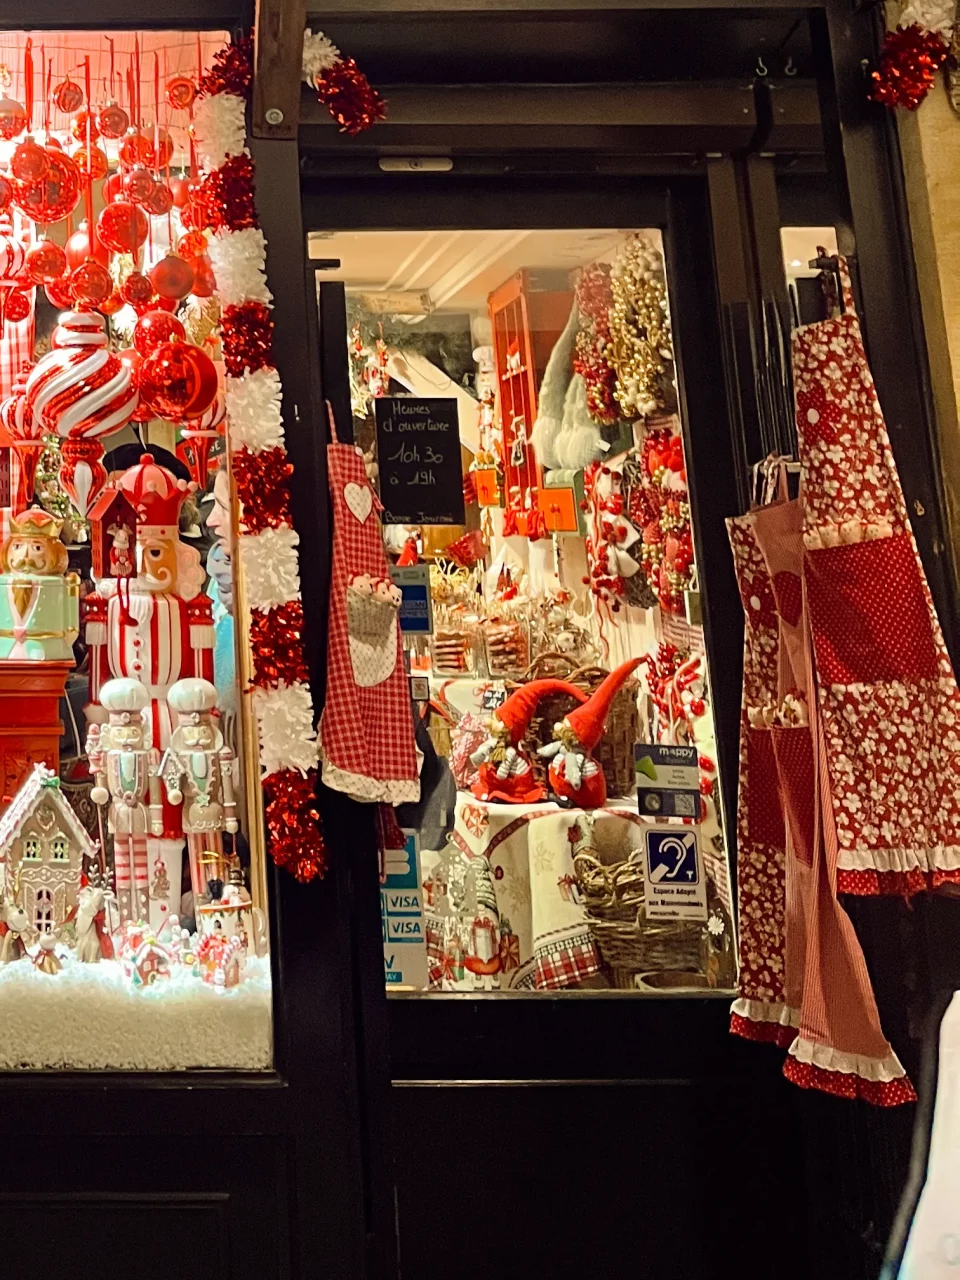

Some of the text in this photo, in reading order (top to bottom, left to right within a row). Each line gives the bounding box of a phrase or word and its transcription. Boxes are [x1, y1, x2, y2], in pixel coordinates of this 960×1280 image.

[392, 400, 431, 415] Heures
[391, 895, 420, 908] VISA
[393, 922, 421, 934] VISA
